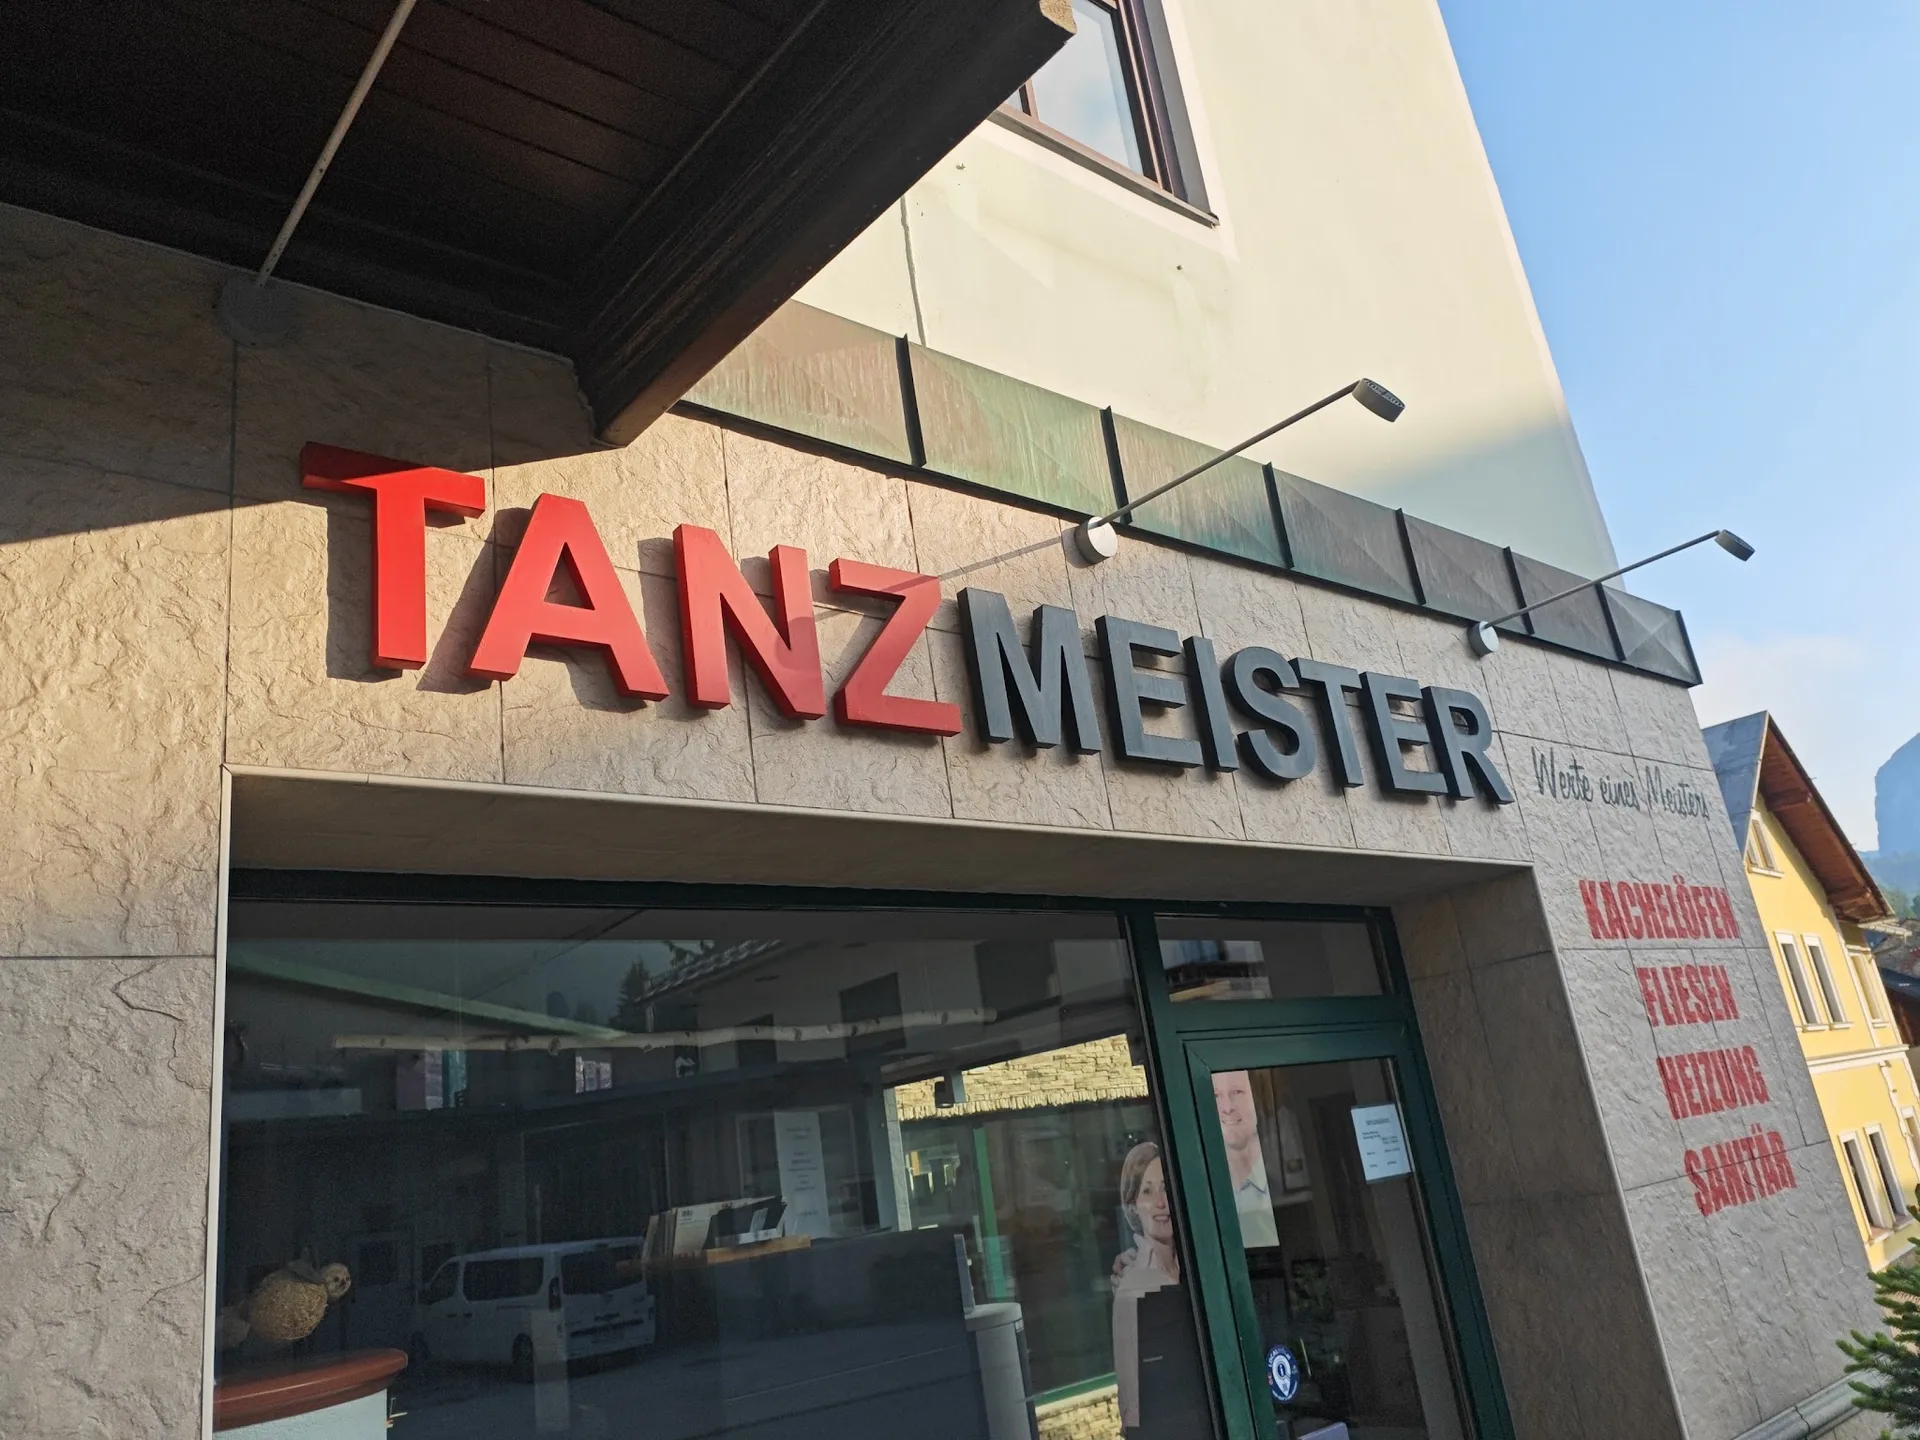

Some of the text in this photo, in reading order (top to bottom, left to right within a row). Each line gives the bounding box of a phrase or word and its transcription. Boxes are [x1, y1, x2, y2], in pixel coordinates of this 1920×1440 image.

[1532, 746, 1710, 821] Werte eines Meisters
[1579, 873, 1741, 940] KACHELÖFEN
[1636, 963, 1740, 1028] FLIESEN
[1656, 1045, 1770, 1120] HEIZUNG
[1684, 1122, 1798, 1217] SANITÄR
